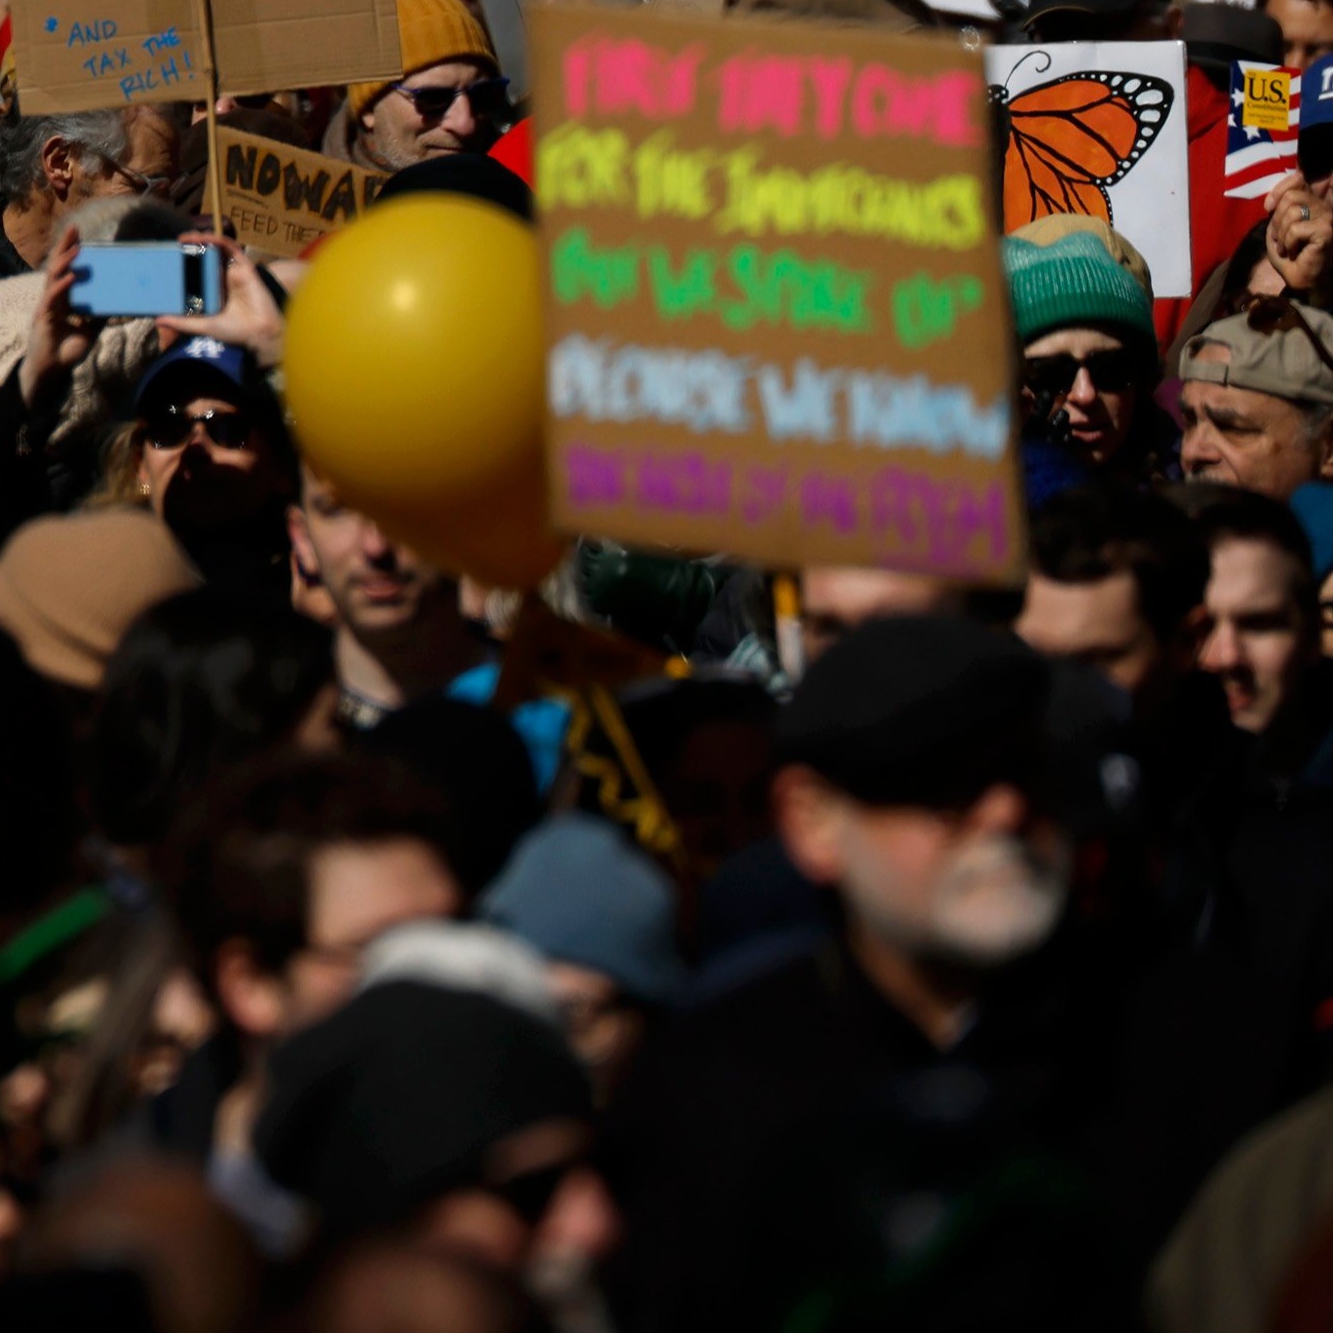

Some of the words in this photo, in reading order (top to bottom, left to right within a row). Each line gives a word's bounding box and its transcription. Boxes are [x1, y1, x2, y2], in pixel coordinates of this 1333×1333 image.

[66, 18, 118, 49] AND
[83, 48, 132, 79] TAX
[142, 25, 182, 54] THE
[120, 50, 197, 103] RICH!
[1248, 77, 1287, 104] U.S.
[230, 206, 279, 236] FEED
[282, 221, 313, 244] THE
